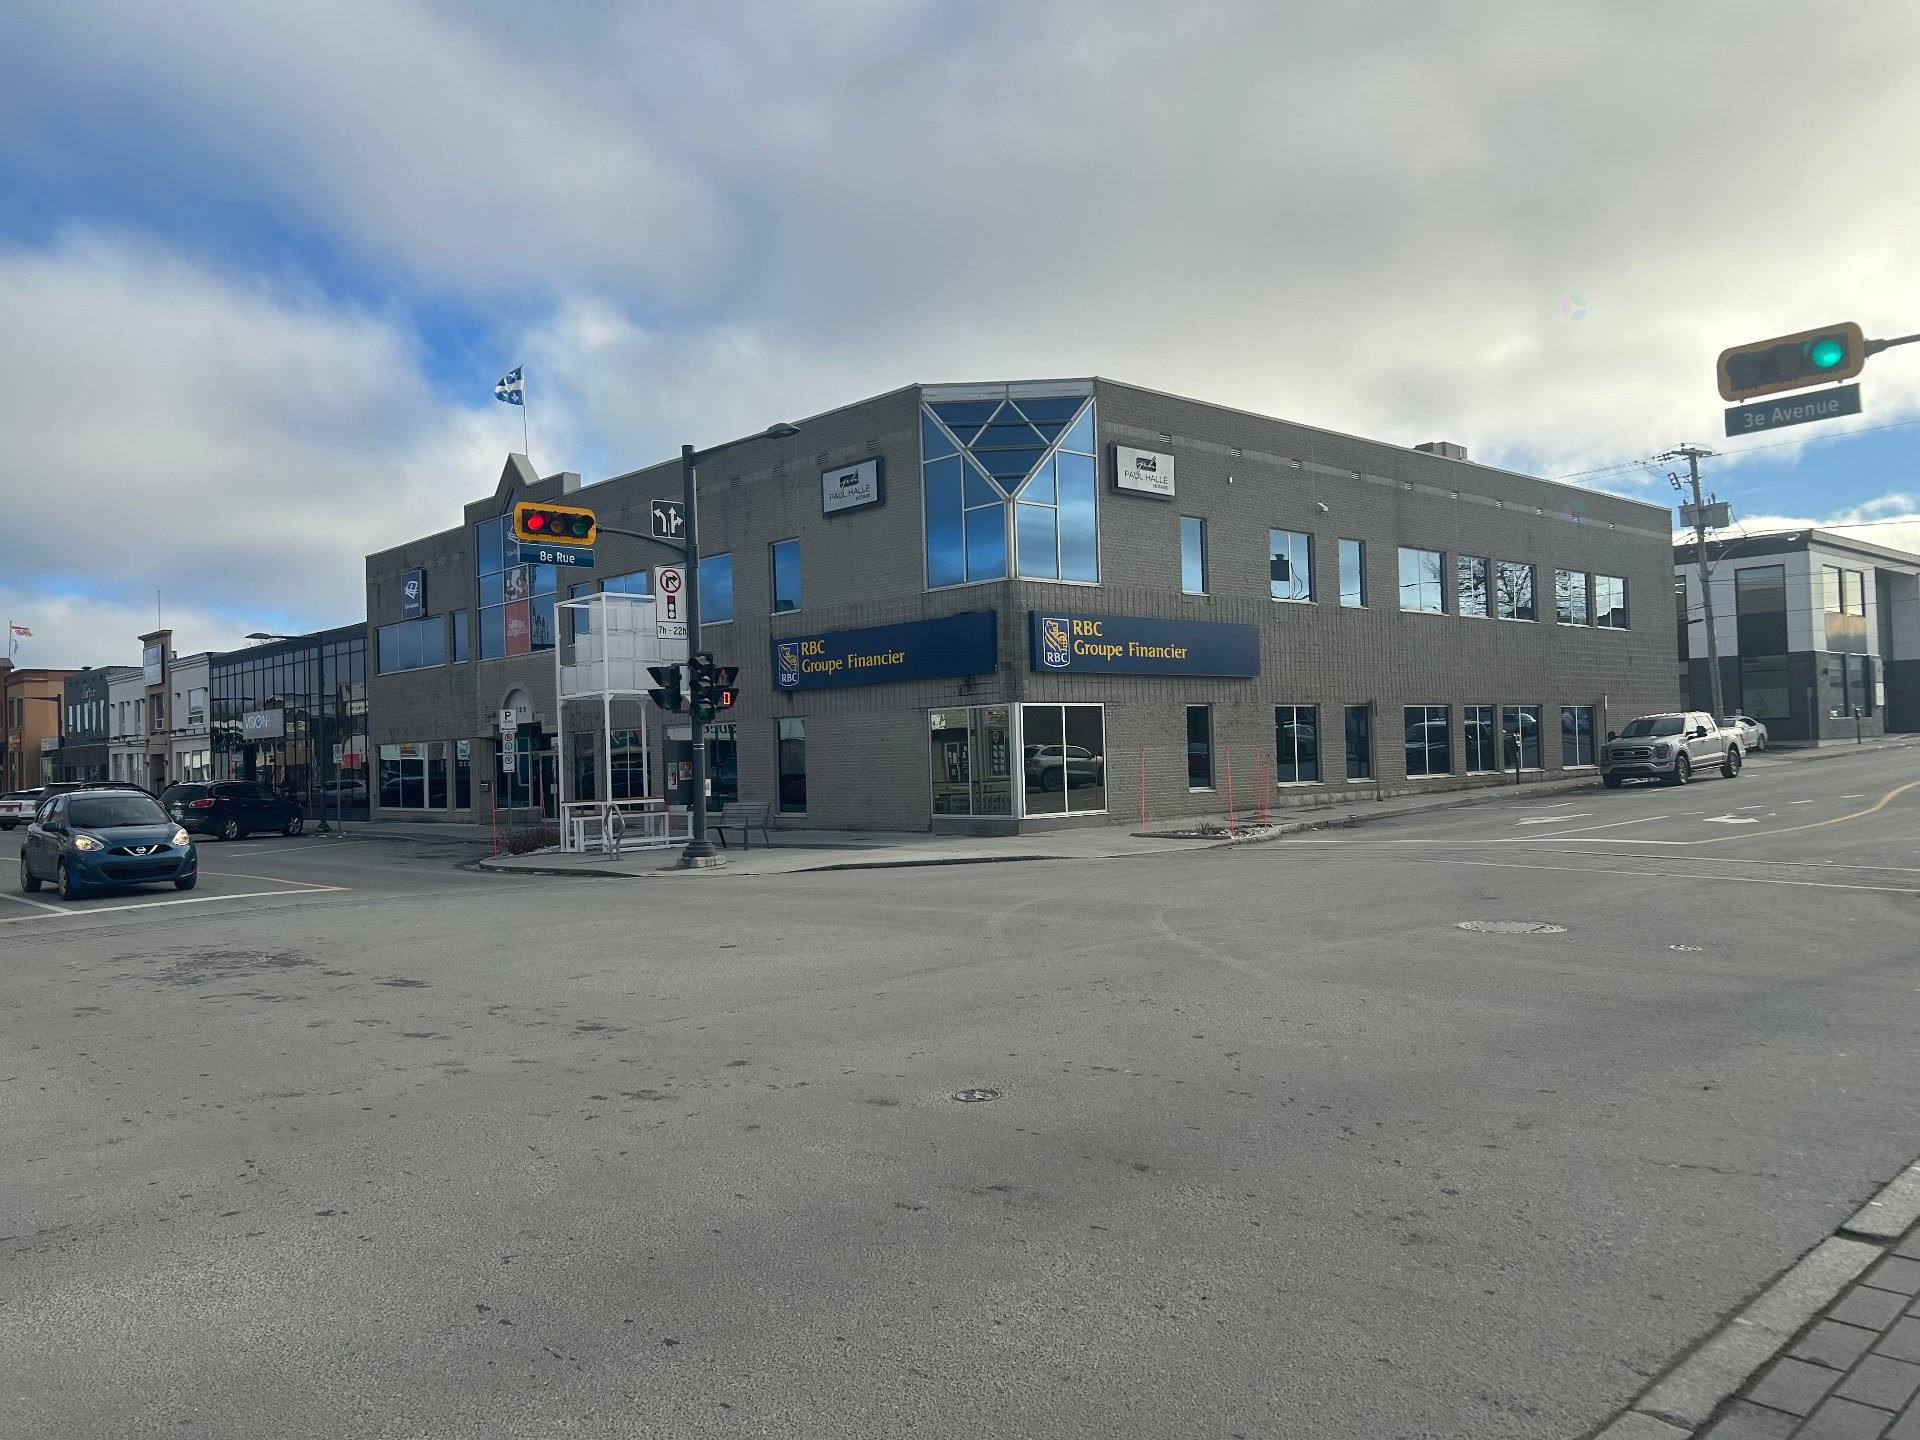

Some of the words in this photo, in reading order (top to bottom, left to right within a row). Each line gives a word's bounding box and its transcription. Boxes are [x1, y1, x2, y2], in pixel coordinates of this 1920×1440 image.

[1743, 412, 1766, 428] 3e
[1771, 399, 1840, 423] Avenue
[1124, 469, 1143, 481] PAUL
[1145, 473, 1168, 485] HALLÉ
[829, 490, 847, 501] PAUL
[539, 550, 553, 562] 8e
[556, 552, 576, 564] Rue
[658, 625, 667, 635] 7h
[673, 626, 687, 636] 22h
[1072, 619, 1103, 637] RBC
[801, 640, 826, 656] RBC
[1073, 639, 1123, 661] Groupe
[1128, 642, 1188, 659] Financier
[801, 659, 843, 676] Groupe
[847, 650, 906, 669] Financier
[1047, 652, 1068, 663] RBC
[781, 672, 797, 683] RBC
[504, 711, 512, 720] P
